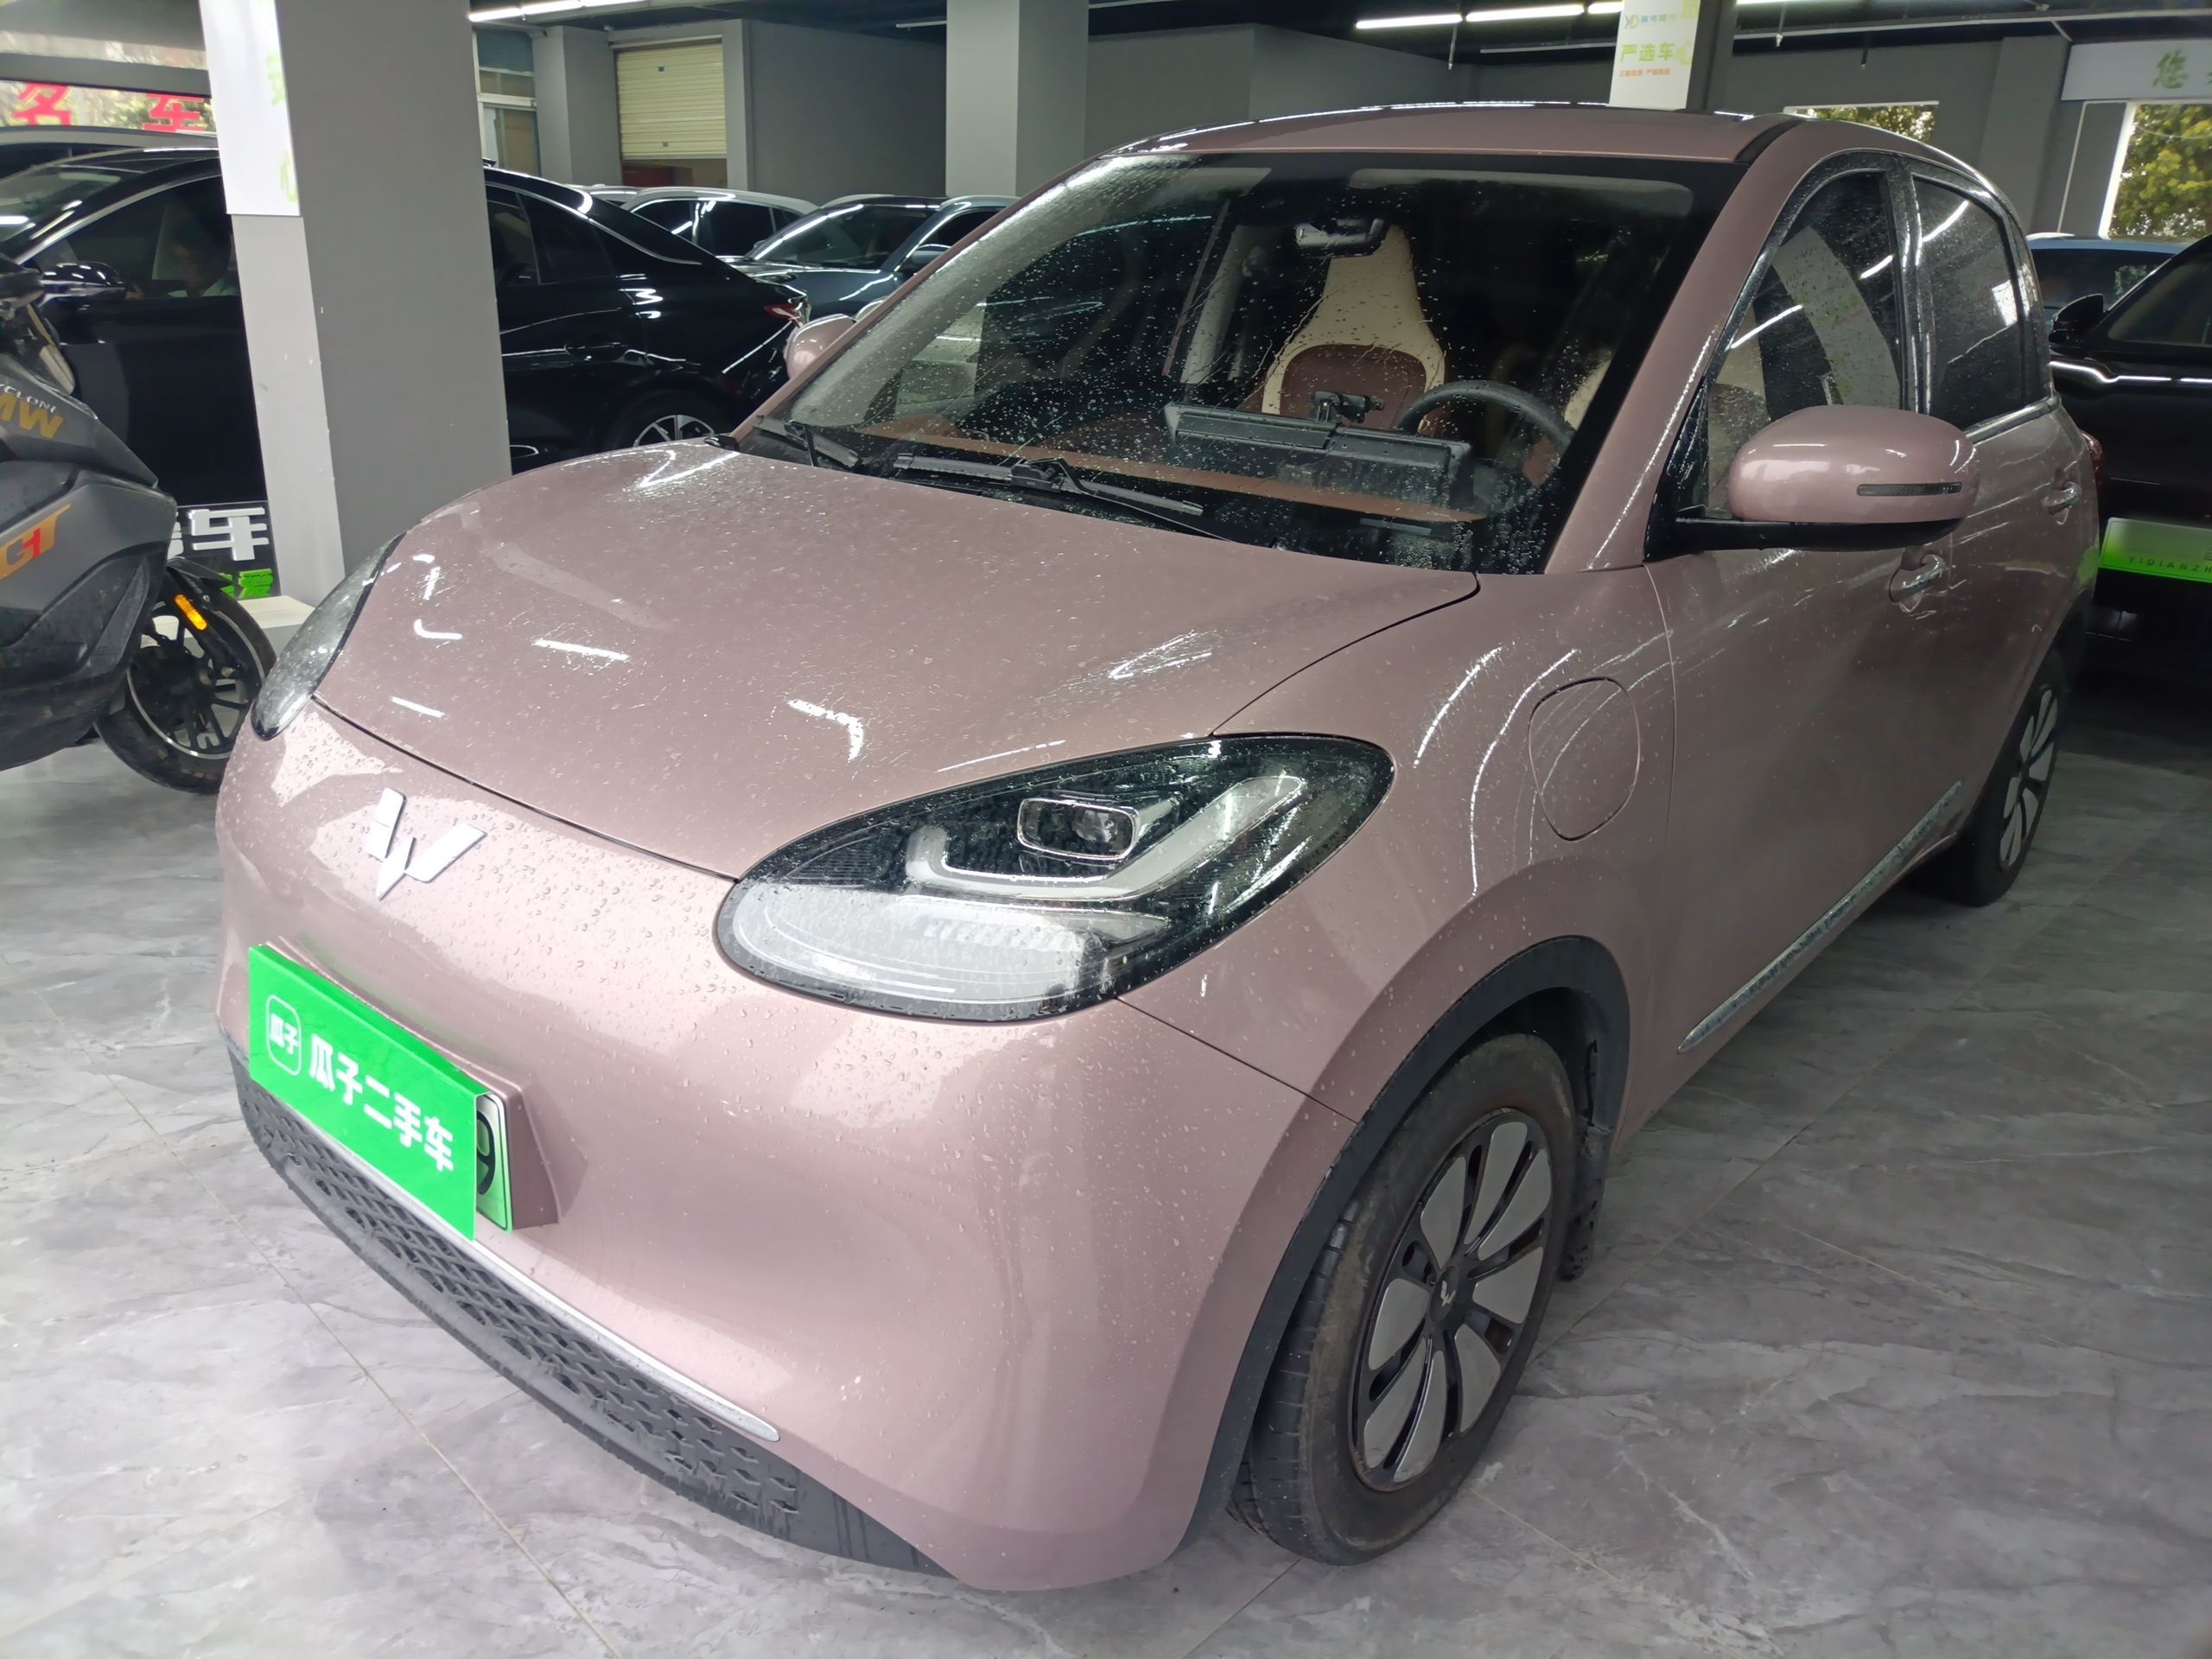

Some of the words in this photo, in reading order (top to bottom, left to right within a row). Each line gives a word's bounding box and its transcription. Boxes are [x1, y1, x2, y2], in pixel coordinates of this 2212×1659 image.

[270, 1013, 299, 1055] 瓜子
[308, 1033, 454, 1173] 瓜子二手车
